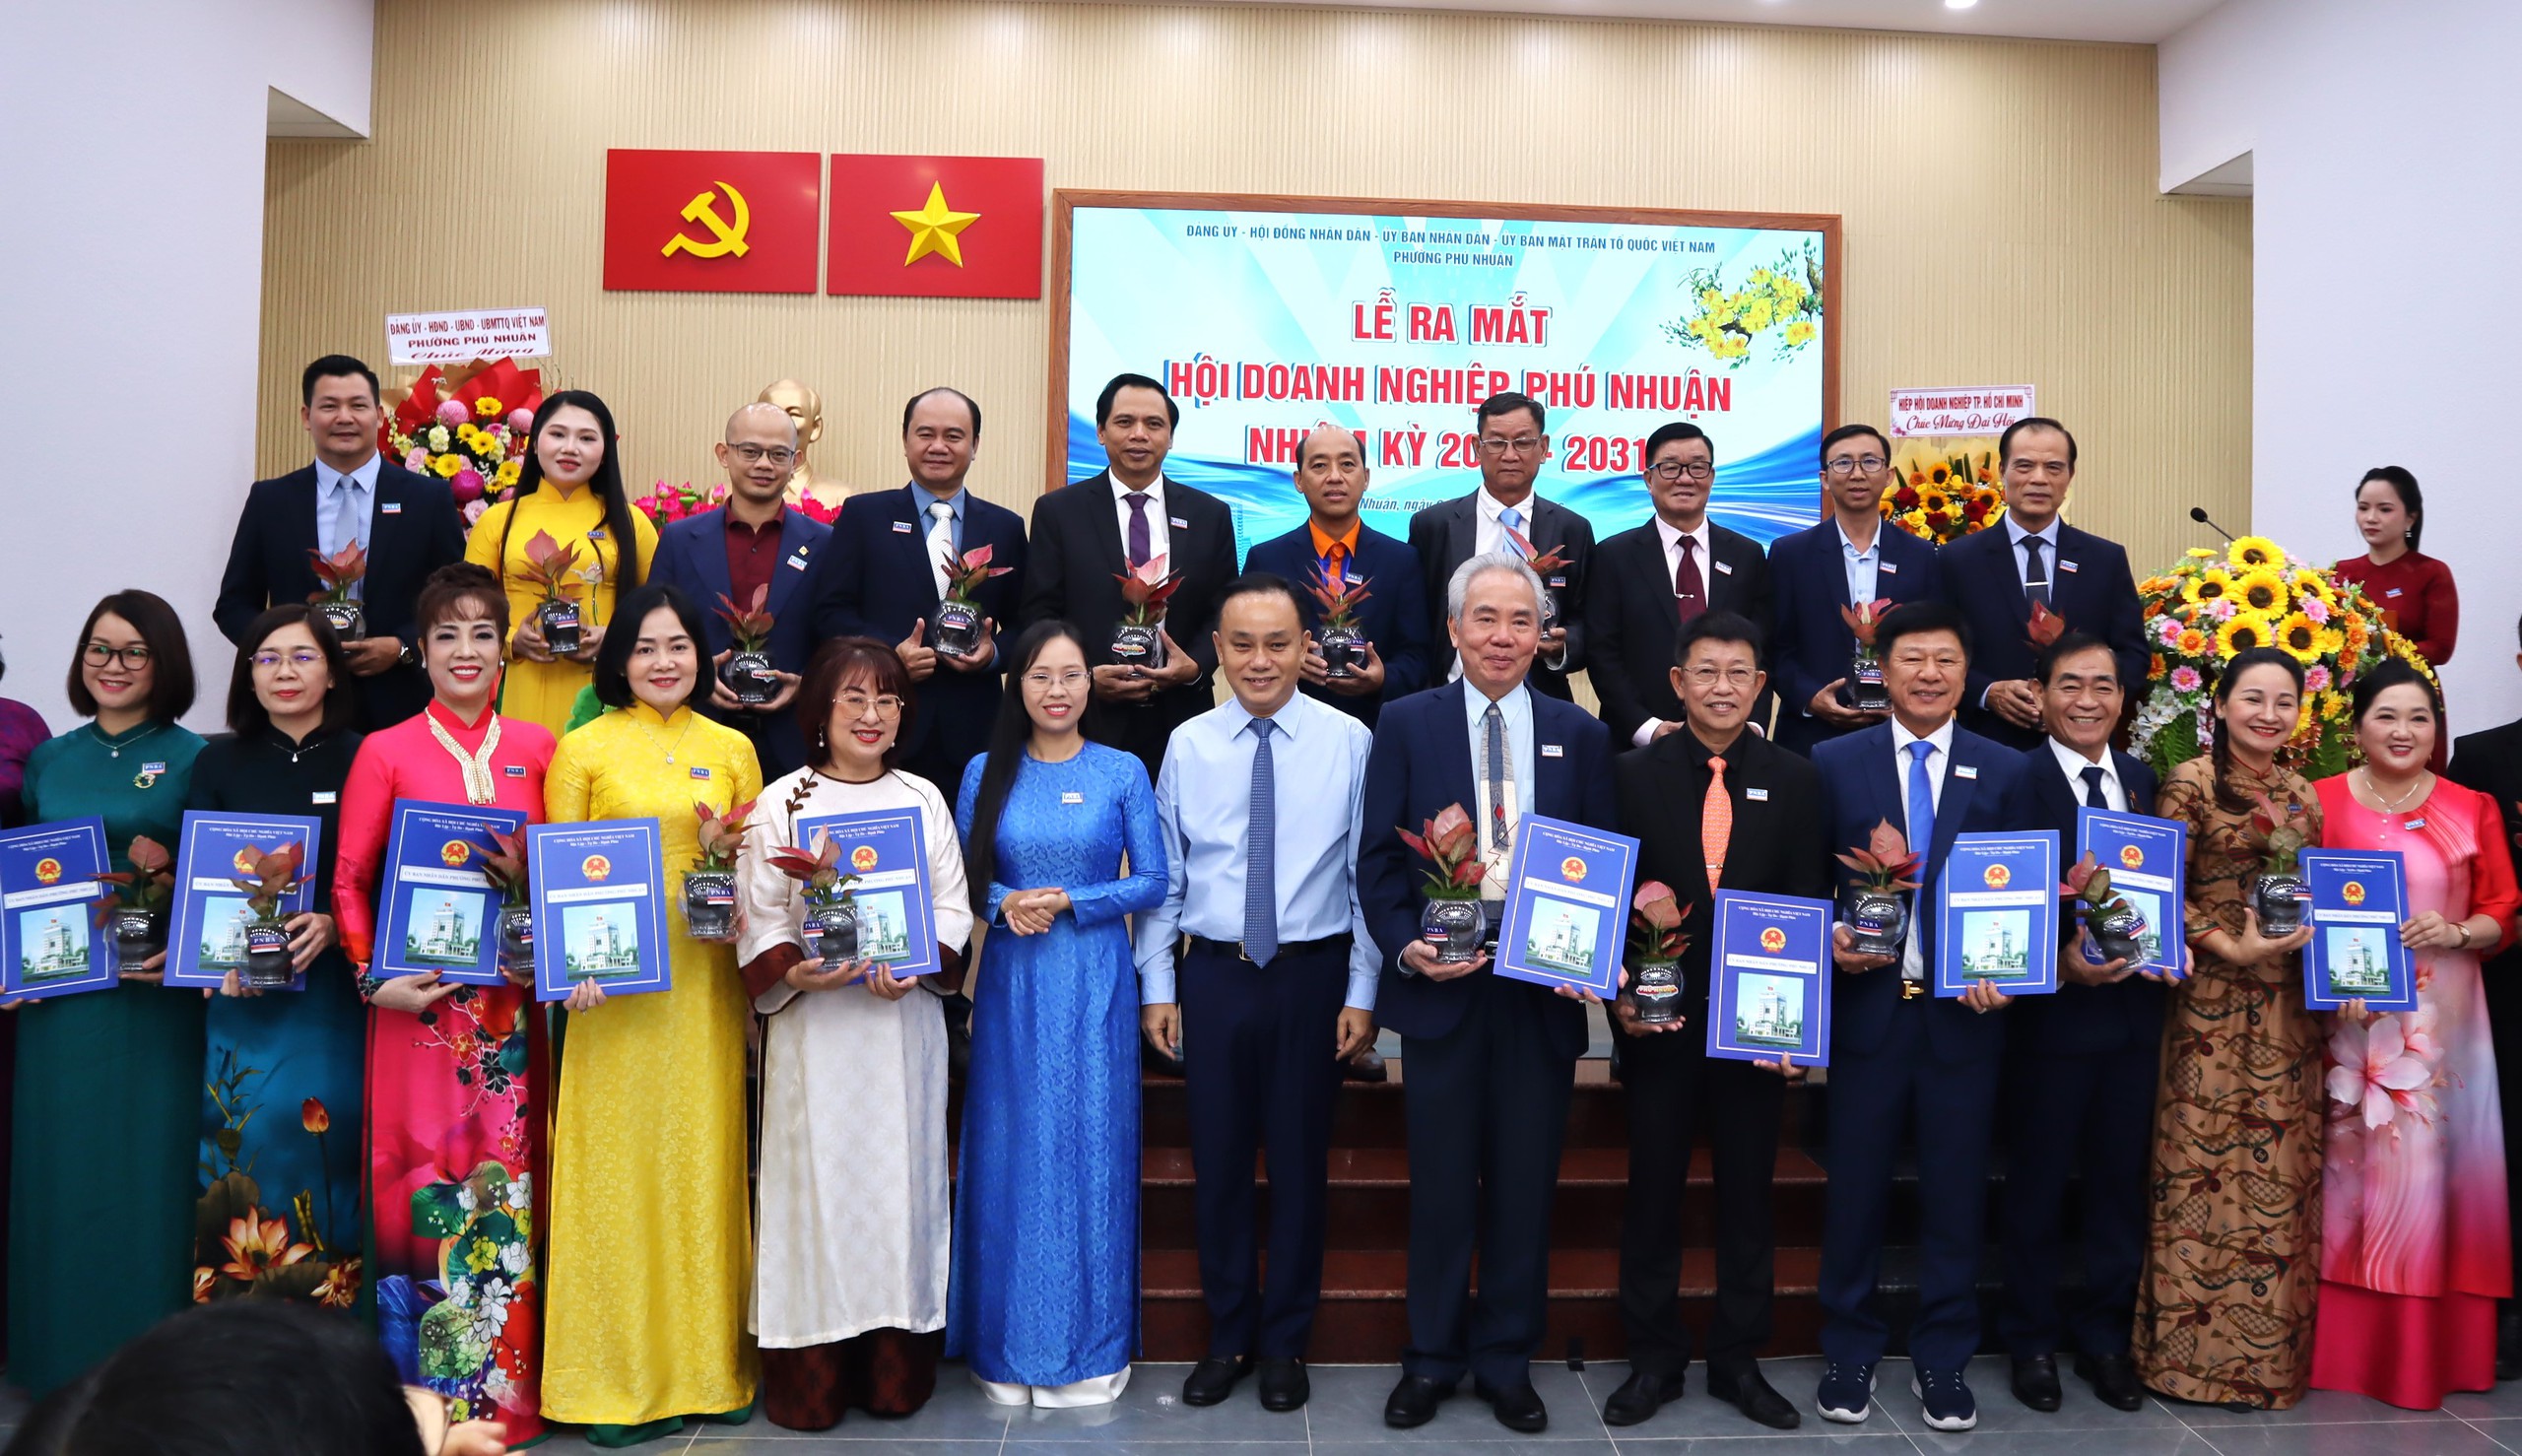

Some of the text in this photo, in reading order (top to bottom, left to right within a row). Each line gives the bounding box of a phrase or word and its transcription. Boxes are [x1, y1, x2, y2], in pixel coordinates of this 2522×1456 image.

[1186, 222, 1219, 237] ĐẢNG
[1223, 223, 1237, 237] ỦY
[1250, 226, 1269, 241] HỘI
[1310, 227, 1343, 240] NHÂN
[1347, 228, 1371, 241] DÂN
[1382, 226, 1398, 242] ỦY
[1401, 232, 1426, 243] BAN
[1429, 230, 1461, 244] NHÂN
[1466, 231, 1490, 245] DÂN
[1501, 230, 1517, 246] ỦY
[1520, 235, 1544, 248] BAN
[1548, 233, 1572, 251] MẶT
[1576, 233, 1606, 252] TRẬN
[1627, 234, 1657, 251] QUỐC
[1662, 236, 1685, 255] VIỆT
[1689, 241, 1715, 253] NAM
[1394, 248, 1513, 268] PHƯỜNG PHÚ NHUẬN
[390, 318, 410, 335] ĐẢNG
[412, 317, 422, 334] ỦY
[429, 320, 448, 333] HĐND
[455, 318, 475, 331] UBND
[481, 317, 510, 331] UBMTTQ
[511, 313, 527, 331] VIỆT
[529, 315, 545, 327] NAM
[1354, 291, 1549, 344] LỄ RA MẮT
[408, 332, 536, 348] PHƯỜNG PHÚ NHUẬN
[1170, 355, 1731, 419] HỘI DOANH NGHIỆP PHÚ NHUẬN
[1899, 395, 1912, 414] HIỆP
[1915, 395, 1924, 414] HỘI
[1927, 397, 1948, 411] DOANH
[1950, 394, 1971, 412] NGHIỆP
[1973, 396, 1982, 410] TP.
[1994, 392, 2004, 409] CHÍ
[2007, 395, 2024, 409] MINH
[1906, 415, 1931, 430] Chúc
[1933, 414, 1964, 431] Mừng
[1966, 414, 1990, 430] Đại
[1382, 423, 1427, 467] KỲ
[1441, 432, 1480, 468] 20
[1567, 435, 1646, 473] 2031
[1360, 497, 1399, 512] Nhuận,
[2128, 918, 2146, 931] PNBA
